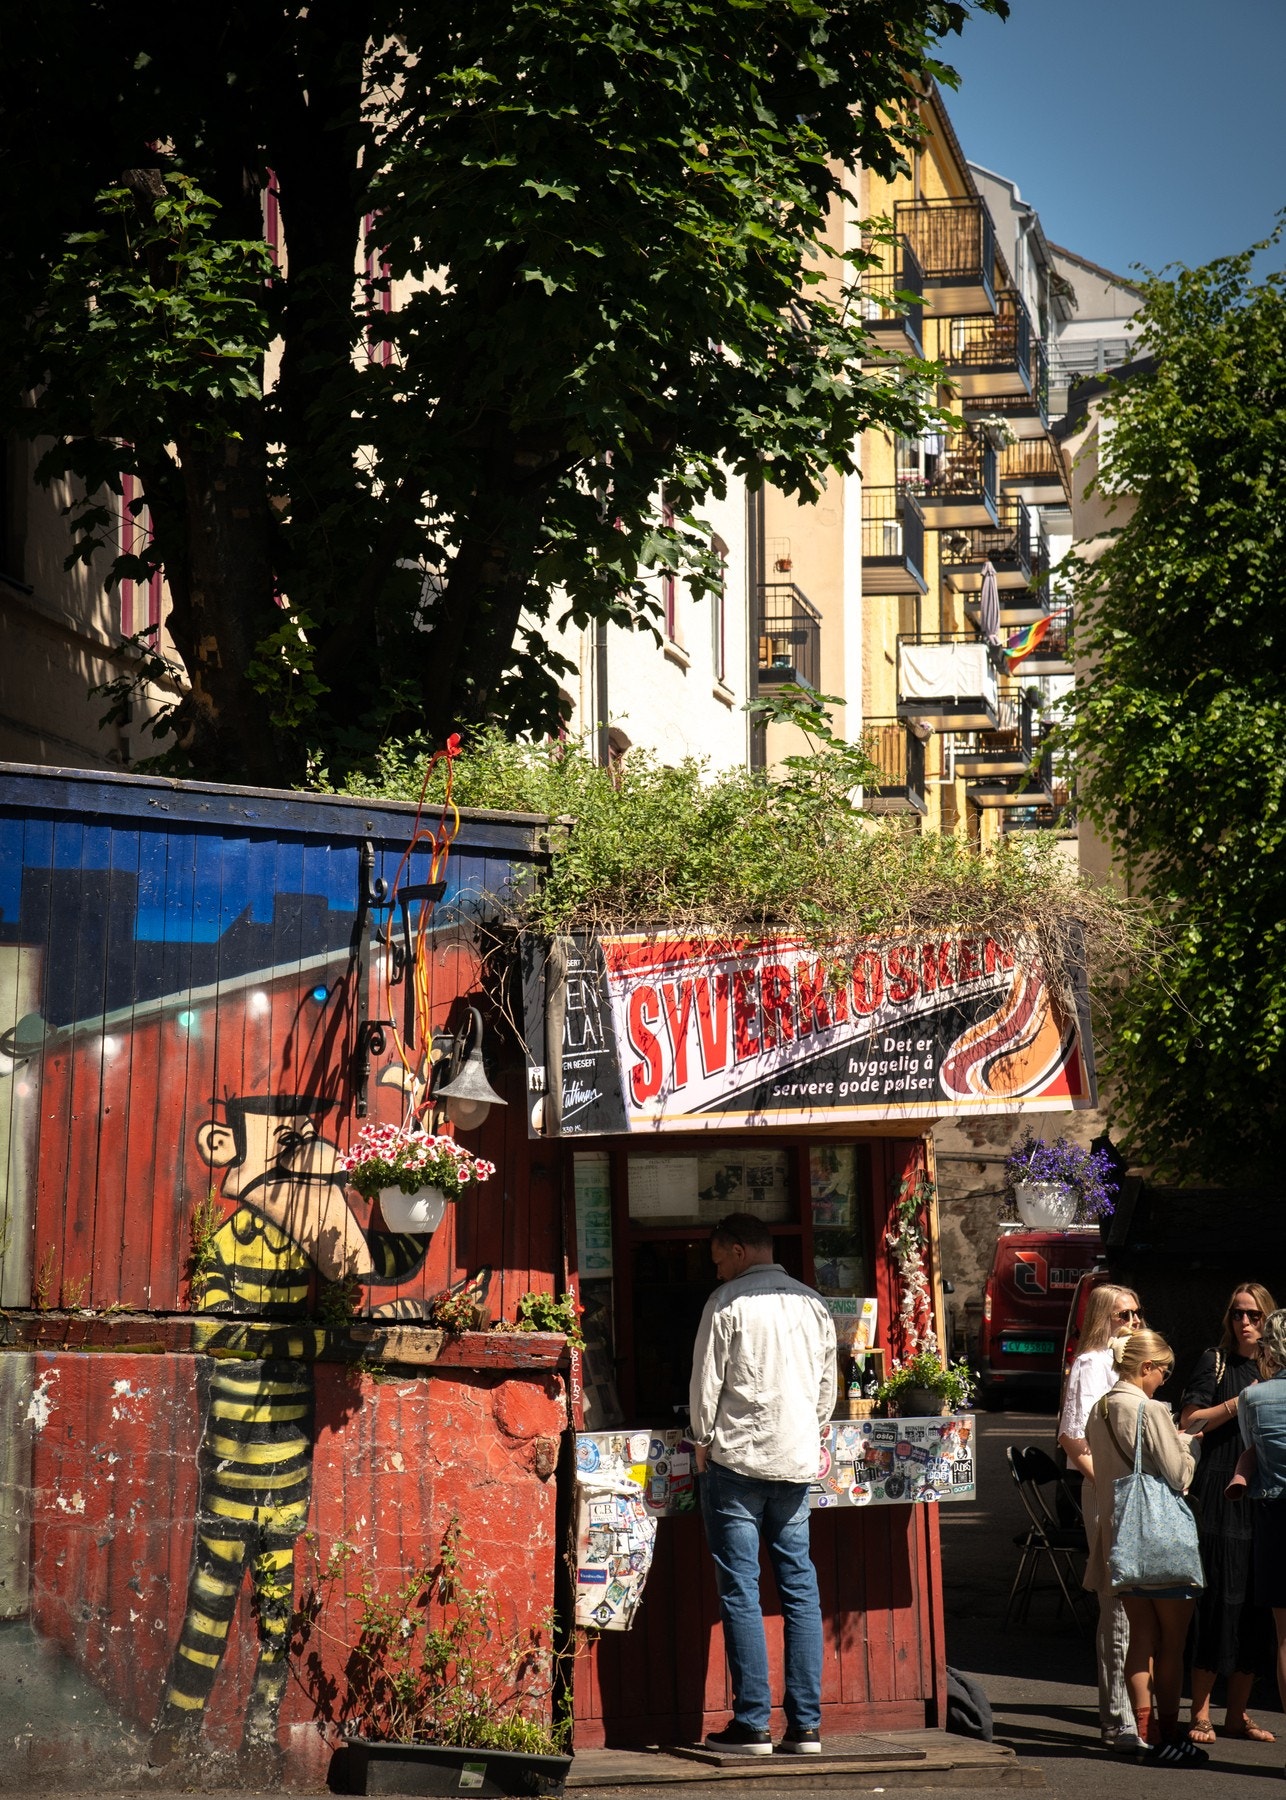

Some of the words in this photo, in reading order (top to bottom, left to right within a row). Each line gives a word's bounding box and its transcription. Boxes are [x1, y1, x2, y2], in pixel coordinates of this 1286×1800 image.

[884, 1037, 913, 1053] Det
[916, 1039, 933, 1051] er
[573, 1058, 596, 1069] RESEPT
[848, 1057, 919, 1077] hyggelig
[923, 1054, 934, 1070] å
[772, 1081, 834, 1097] servere
[839, 1077, 880, 1097] gode
[884, 1074, 935, 1095] pølser
[1008, 1342, 1021, 1351] CV
[1023, 1342, 1053, 1352] 95802
